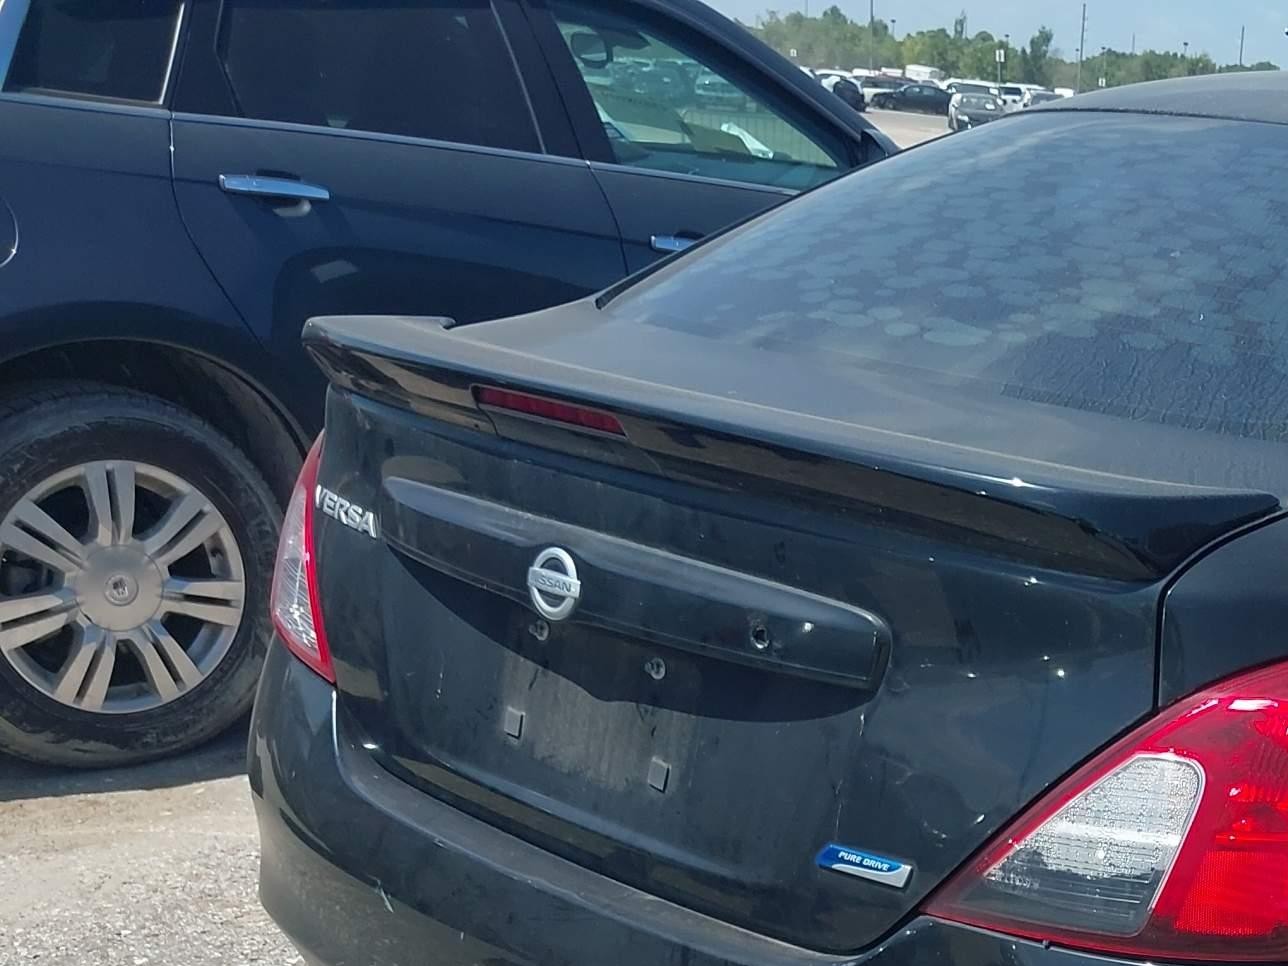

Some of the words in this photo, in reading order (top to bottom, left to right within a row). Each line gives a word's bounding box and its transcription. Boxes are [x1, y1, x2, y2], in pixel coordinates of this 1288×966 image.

[315, 484, 377, 538] VERSA
[533, 573, 572, 593] ISSAN
[838, 851, 863, 865] PURE
[862, 858, 891, 872] DRIVE
